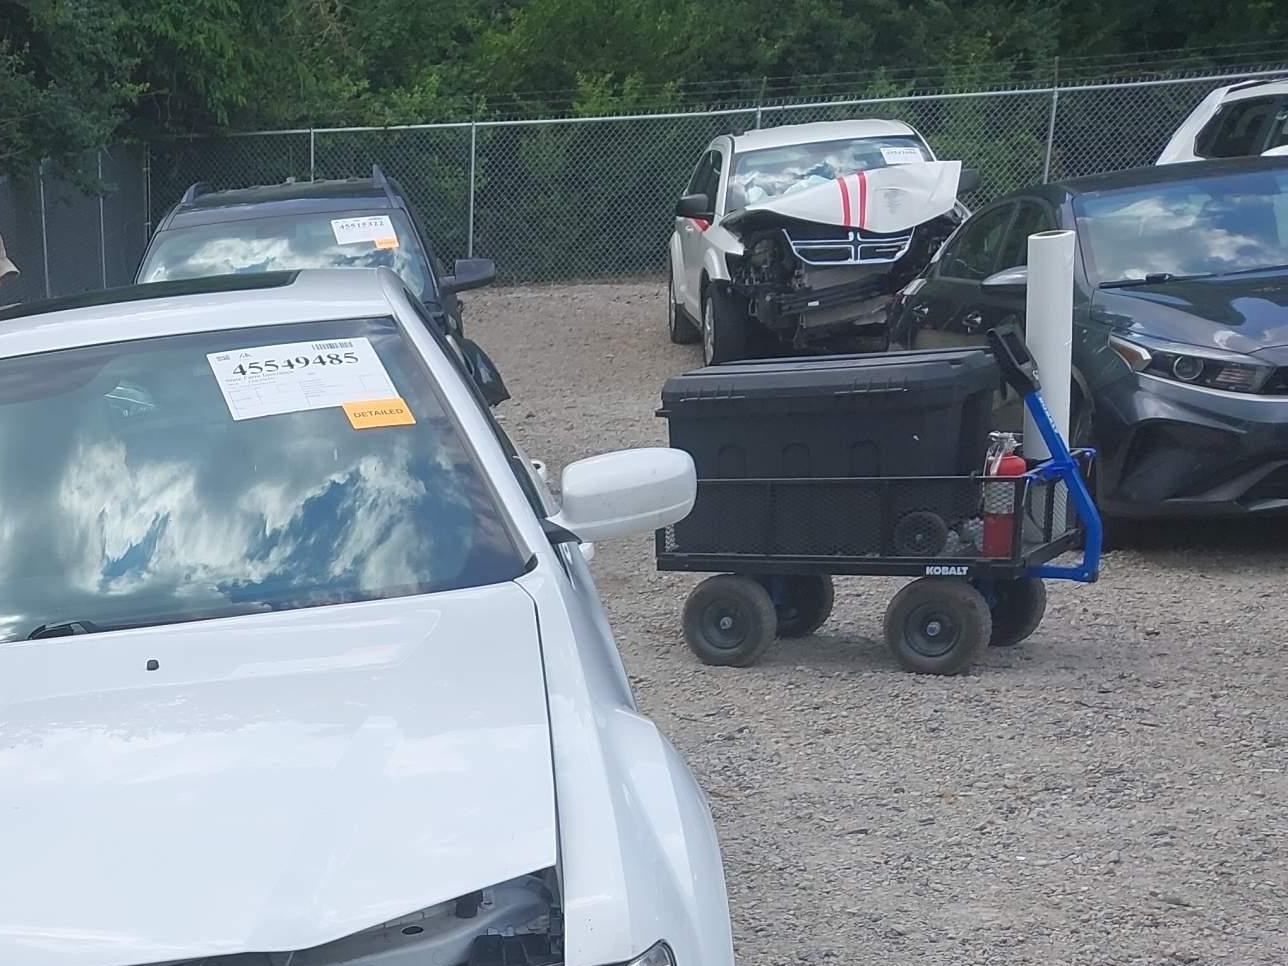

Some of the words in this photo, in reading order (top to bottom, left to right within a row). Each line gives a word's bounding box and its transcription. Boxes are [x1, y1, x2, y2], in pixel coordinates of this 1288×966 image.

[232, 351, 359, 376] 45549485
[353, 408, 404, 418] DETAILED
[925, 566, 969, 576] KOBALT
